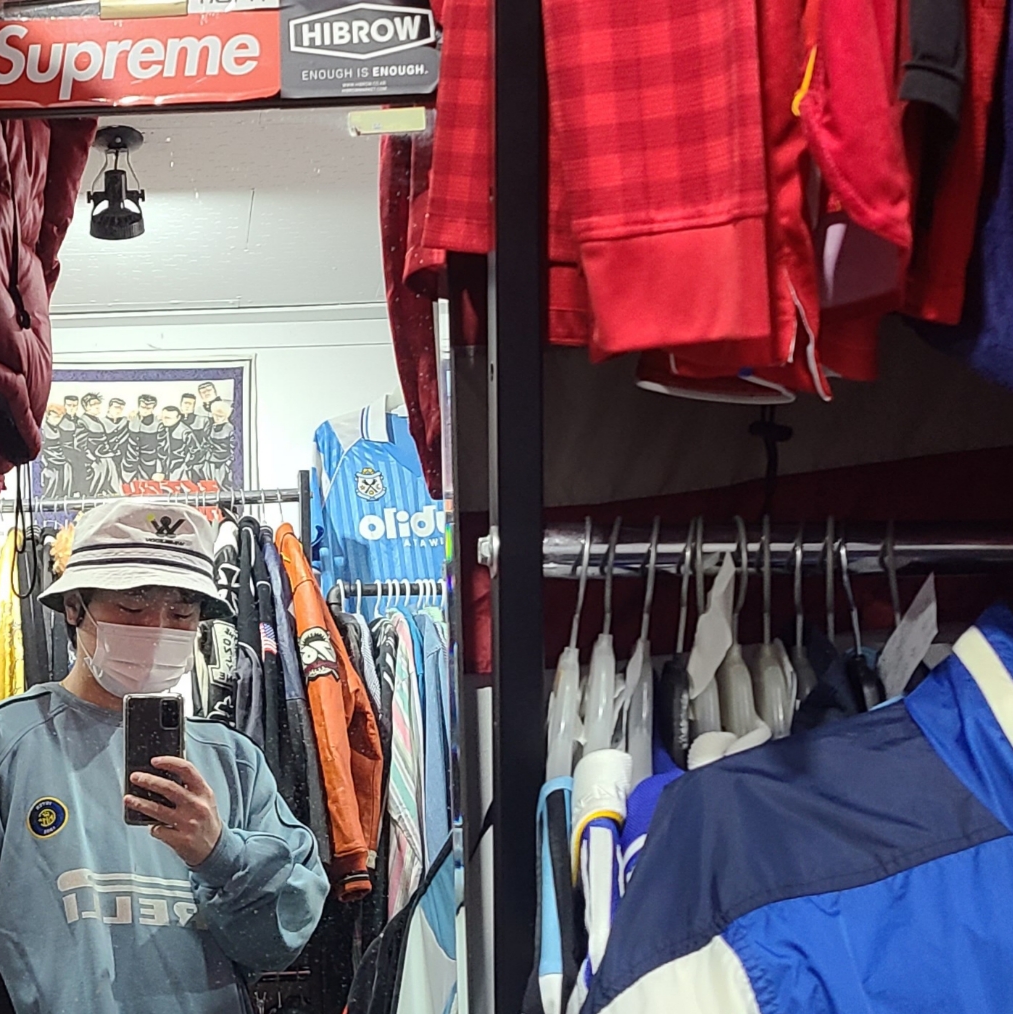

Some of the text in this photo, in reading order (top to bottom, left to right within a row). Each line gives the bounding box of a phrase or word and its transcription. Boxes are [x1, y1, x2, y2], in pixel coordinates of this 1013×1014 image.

[302, 15, 421, 46] HIBROW
[301, 64, 429, 81] ENOUGH IS ENOUGH.
